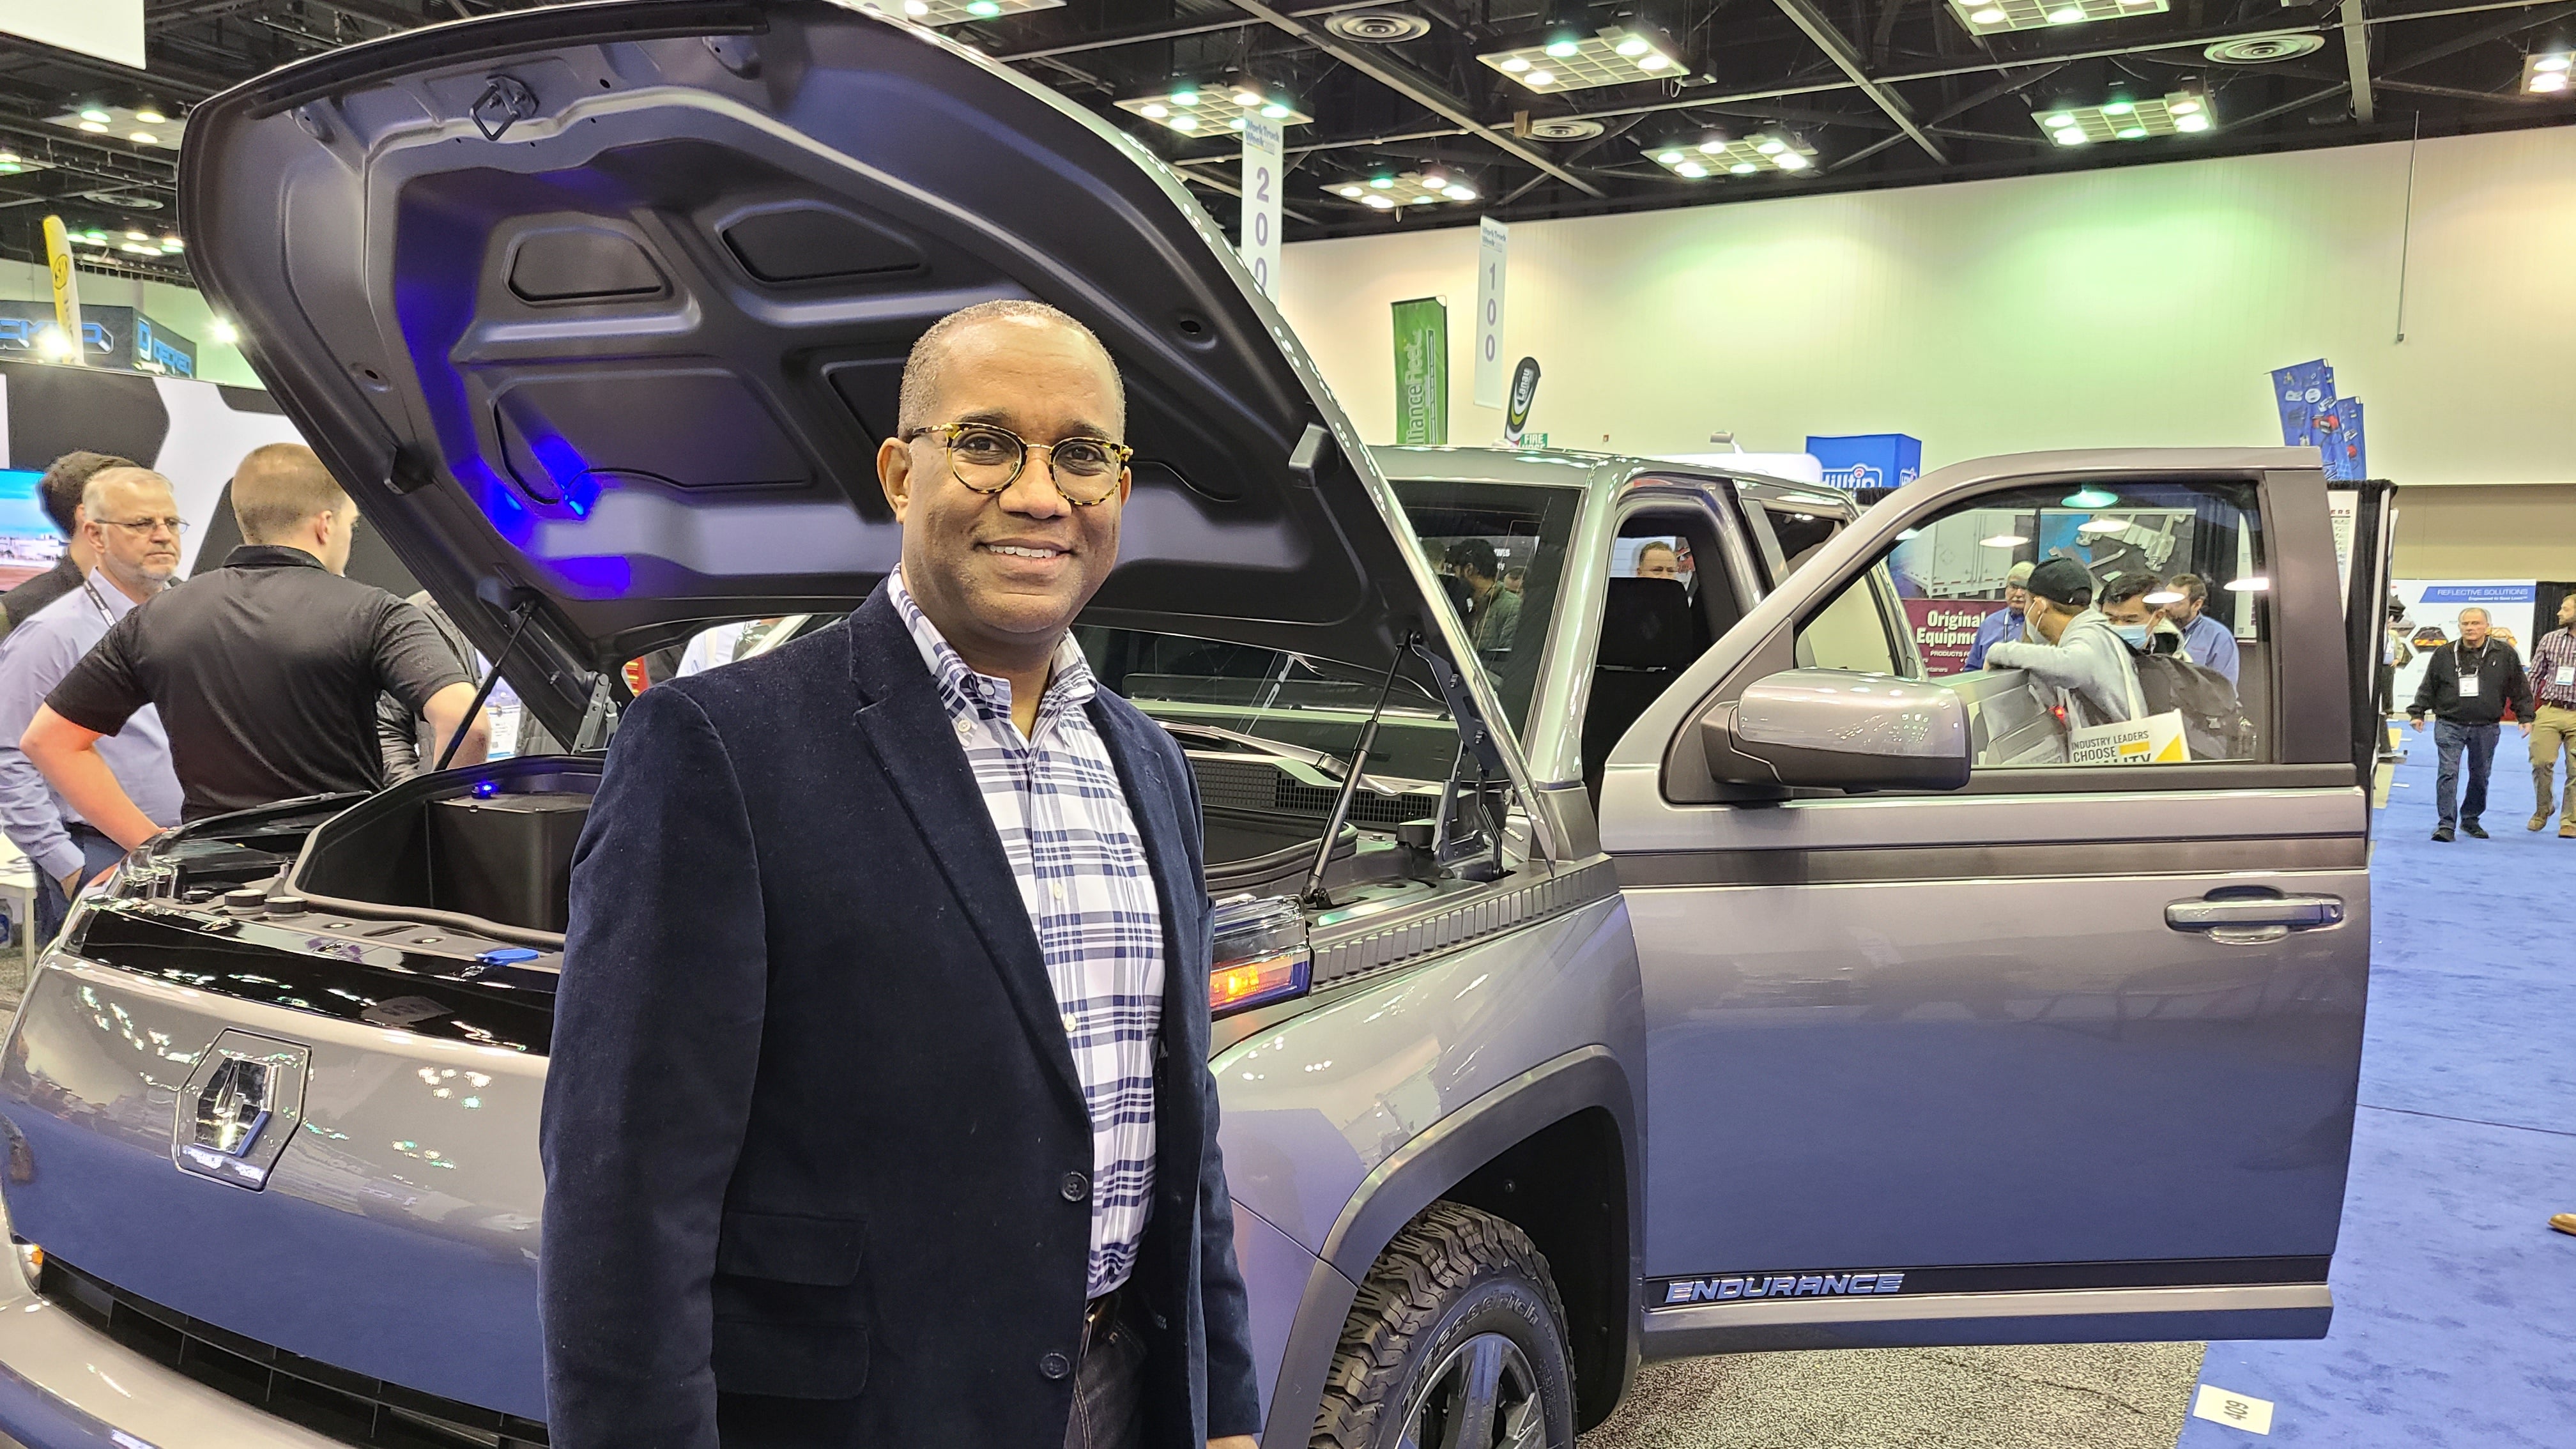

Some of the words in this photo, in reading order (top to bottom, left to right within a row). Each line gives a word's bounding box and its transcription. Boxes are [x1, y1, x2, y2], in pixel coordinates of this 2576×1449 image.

[1245, 130, 1264, 147] Week
[1263, 125, 1280, 142] Truck
[1255, 167, 1269, 289] 200
[1485, 261, 1496, 363] 100
[1524, 434, 1544, 444] FIRE
[1928, 610, 1986, 630] Original
[2071, 737, 2111, 750] INDUSTRY
[2113, 731, 2149, 744] LEADERS
[2073, 746, 2116, 763] CHOOSE
[1665, 1273, 1905, 1303] ENDURANCE
[2223, 1400, 2249, 1421] 409
